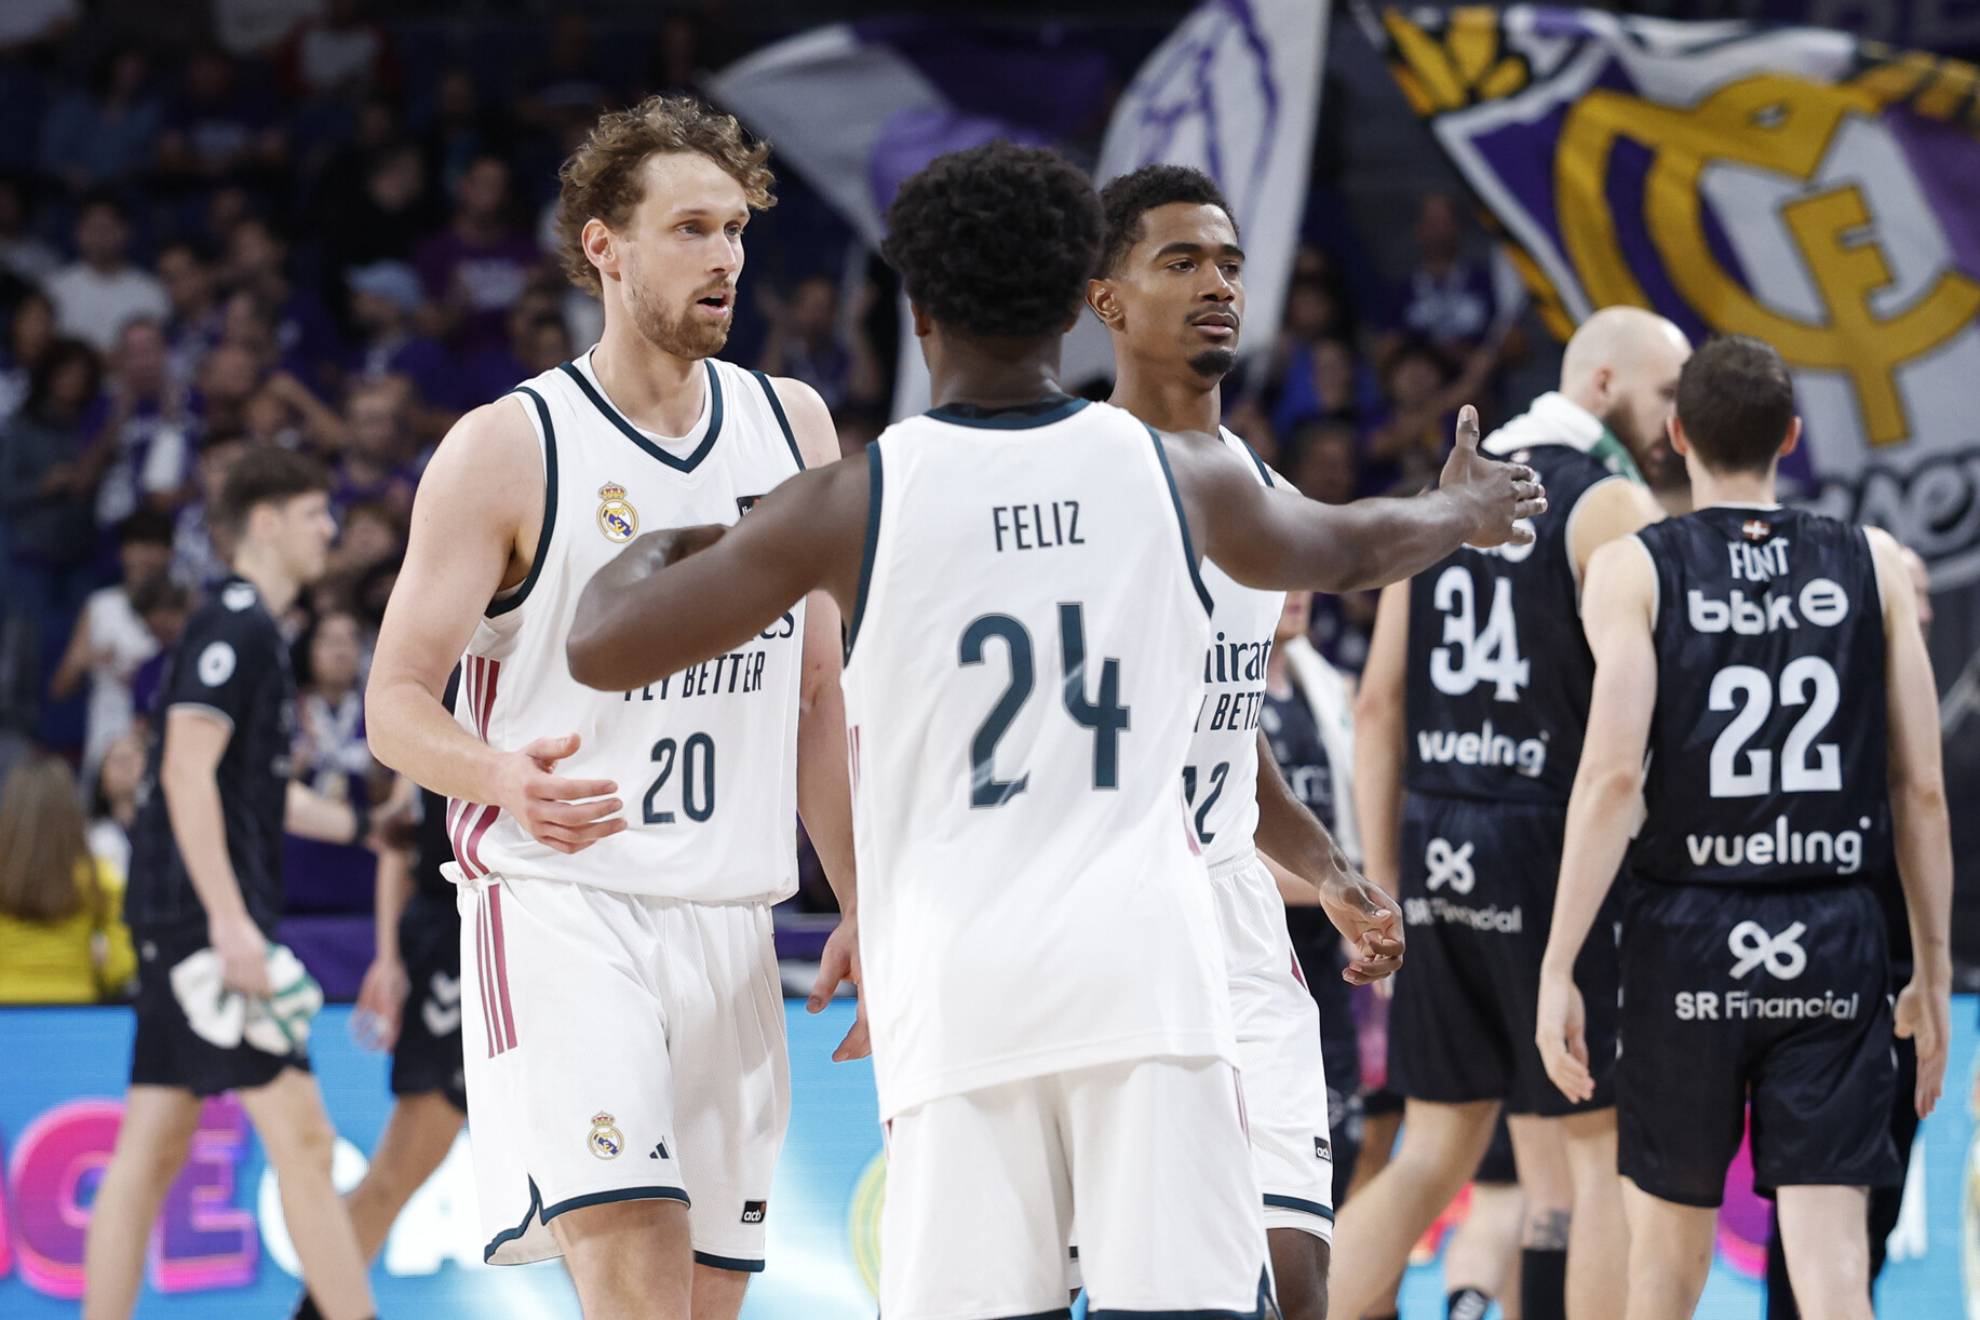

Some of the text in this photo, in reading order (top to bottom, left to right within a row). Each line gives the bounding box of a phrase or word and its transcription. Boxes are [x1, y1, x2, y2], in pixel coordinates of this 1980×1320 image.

[992, 499, 1085, 552] FELIZ
[1429, 565, 1531, 702] 34
[1687, 589, 1799, 636] bbk
[682, 651, 766, 699] BETTER
[1203, 631, 1272, 684] irat
[958, 600, 1131, 810] 24
[1708, 655, 1843, 798] 22
[642, 731, 716, 826] 20
[1686, 814, 1872, 875] vueling
[1675, 989, 1859, 1021] SR Financial
